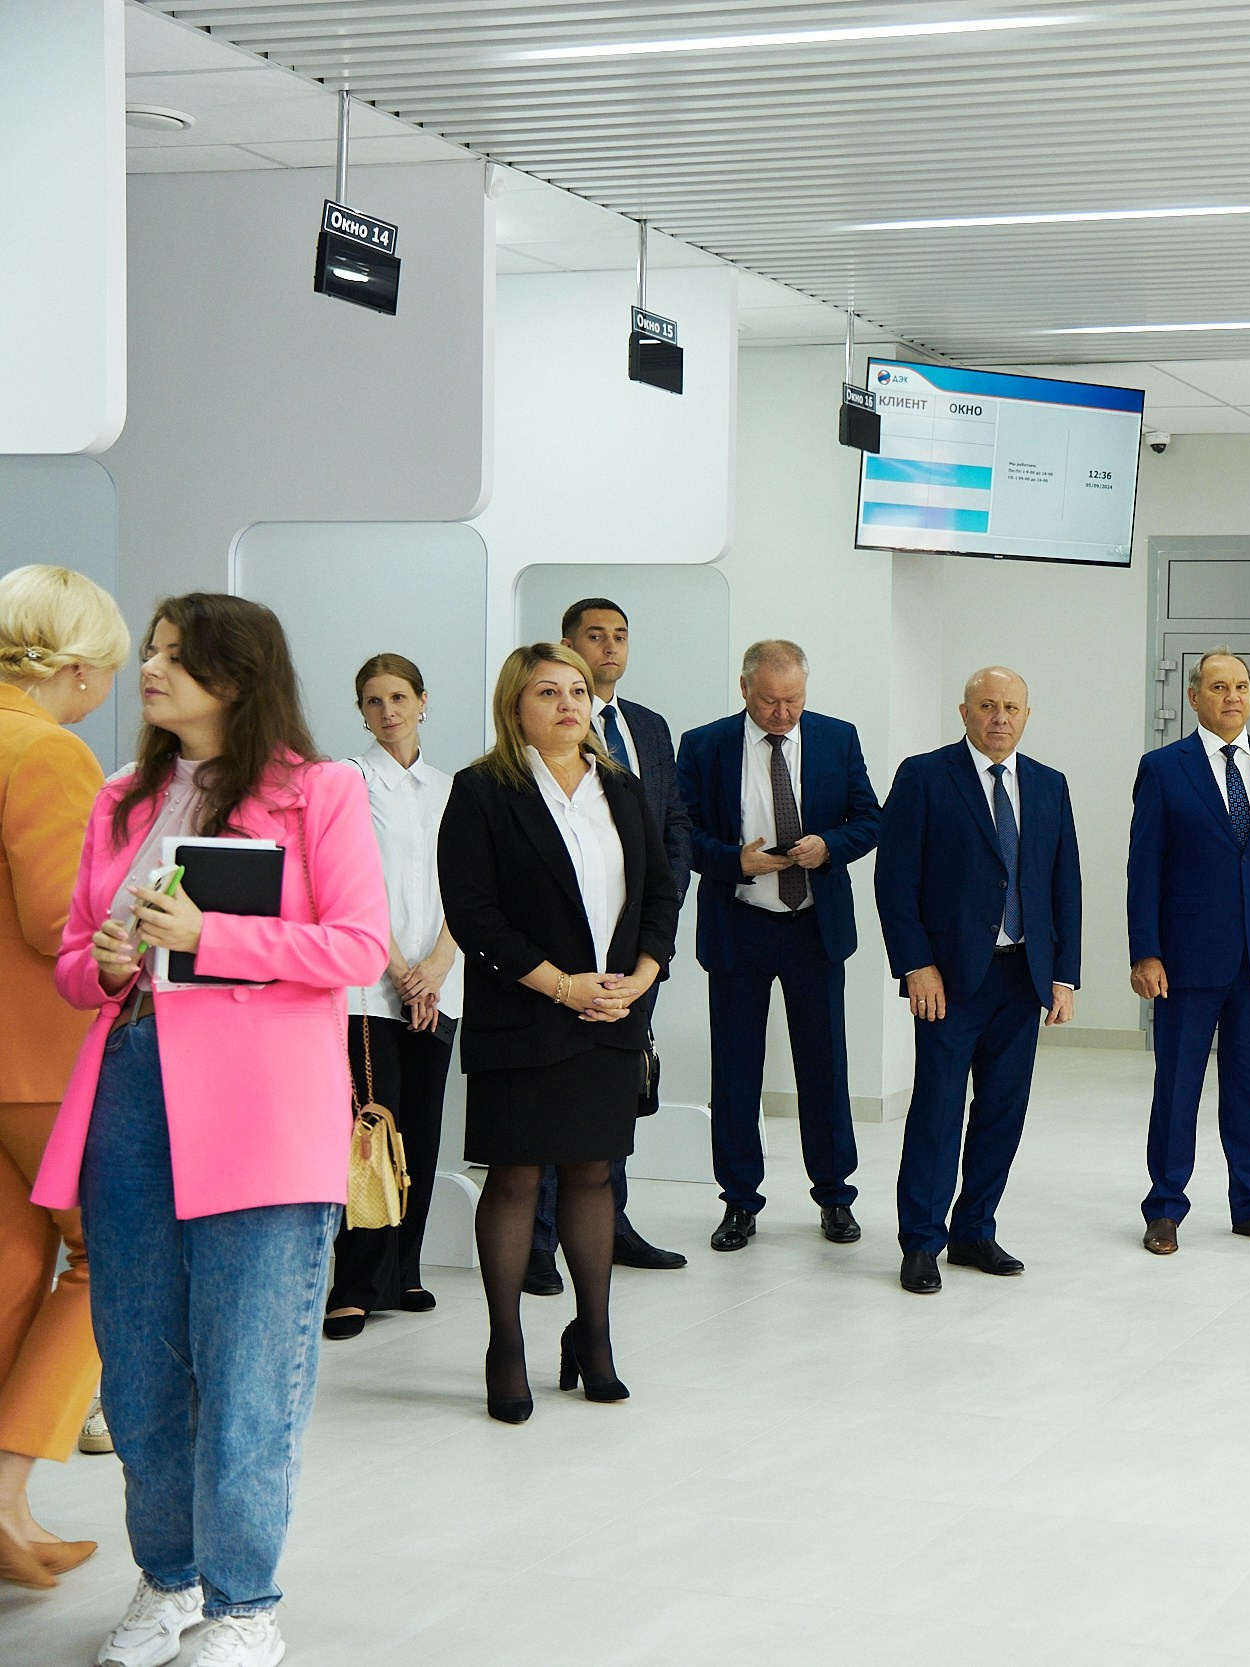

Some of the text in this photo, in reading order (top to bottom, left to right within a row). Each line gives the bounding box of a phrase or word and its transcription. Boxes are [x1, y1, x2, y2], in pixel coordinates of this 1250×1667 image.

[331, 211, 389, 246] Окно 14
[636, 313, 674, 338] Окно 15
[892, 375, 909, 384] ДЭК
[846, 389, 873, 408] Окно 16
[879, 395, 928, 410] КЛИЕНТ
[949, 403, 983, 416] ОКНО
[1088, 470, 1112, 480] 12:36
[1085, 482, 1113, 490] 05/09/2024
